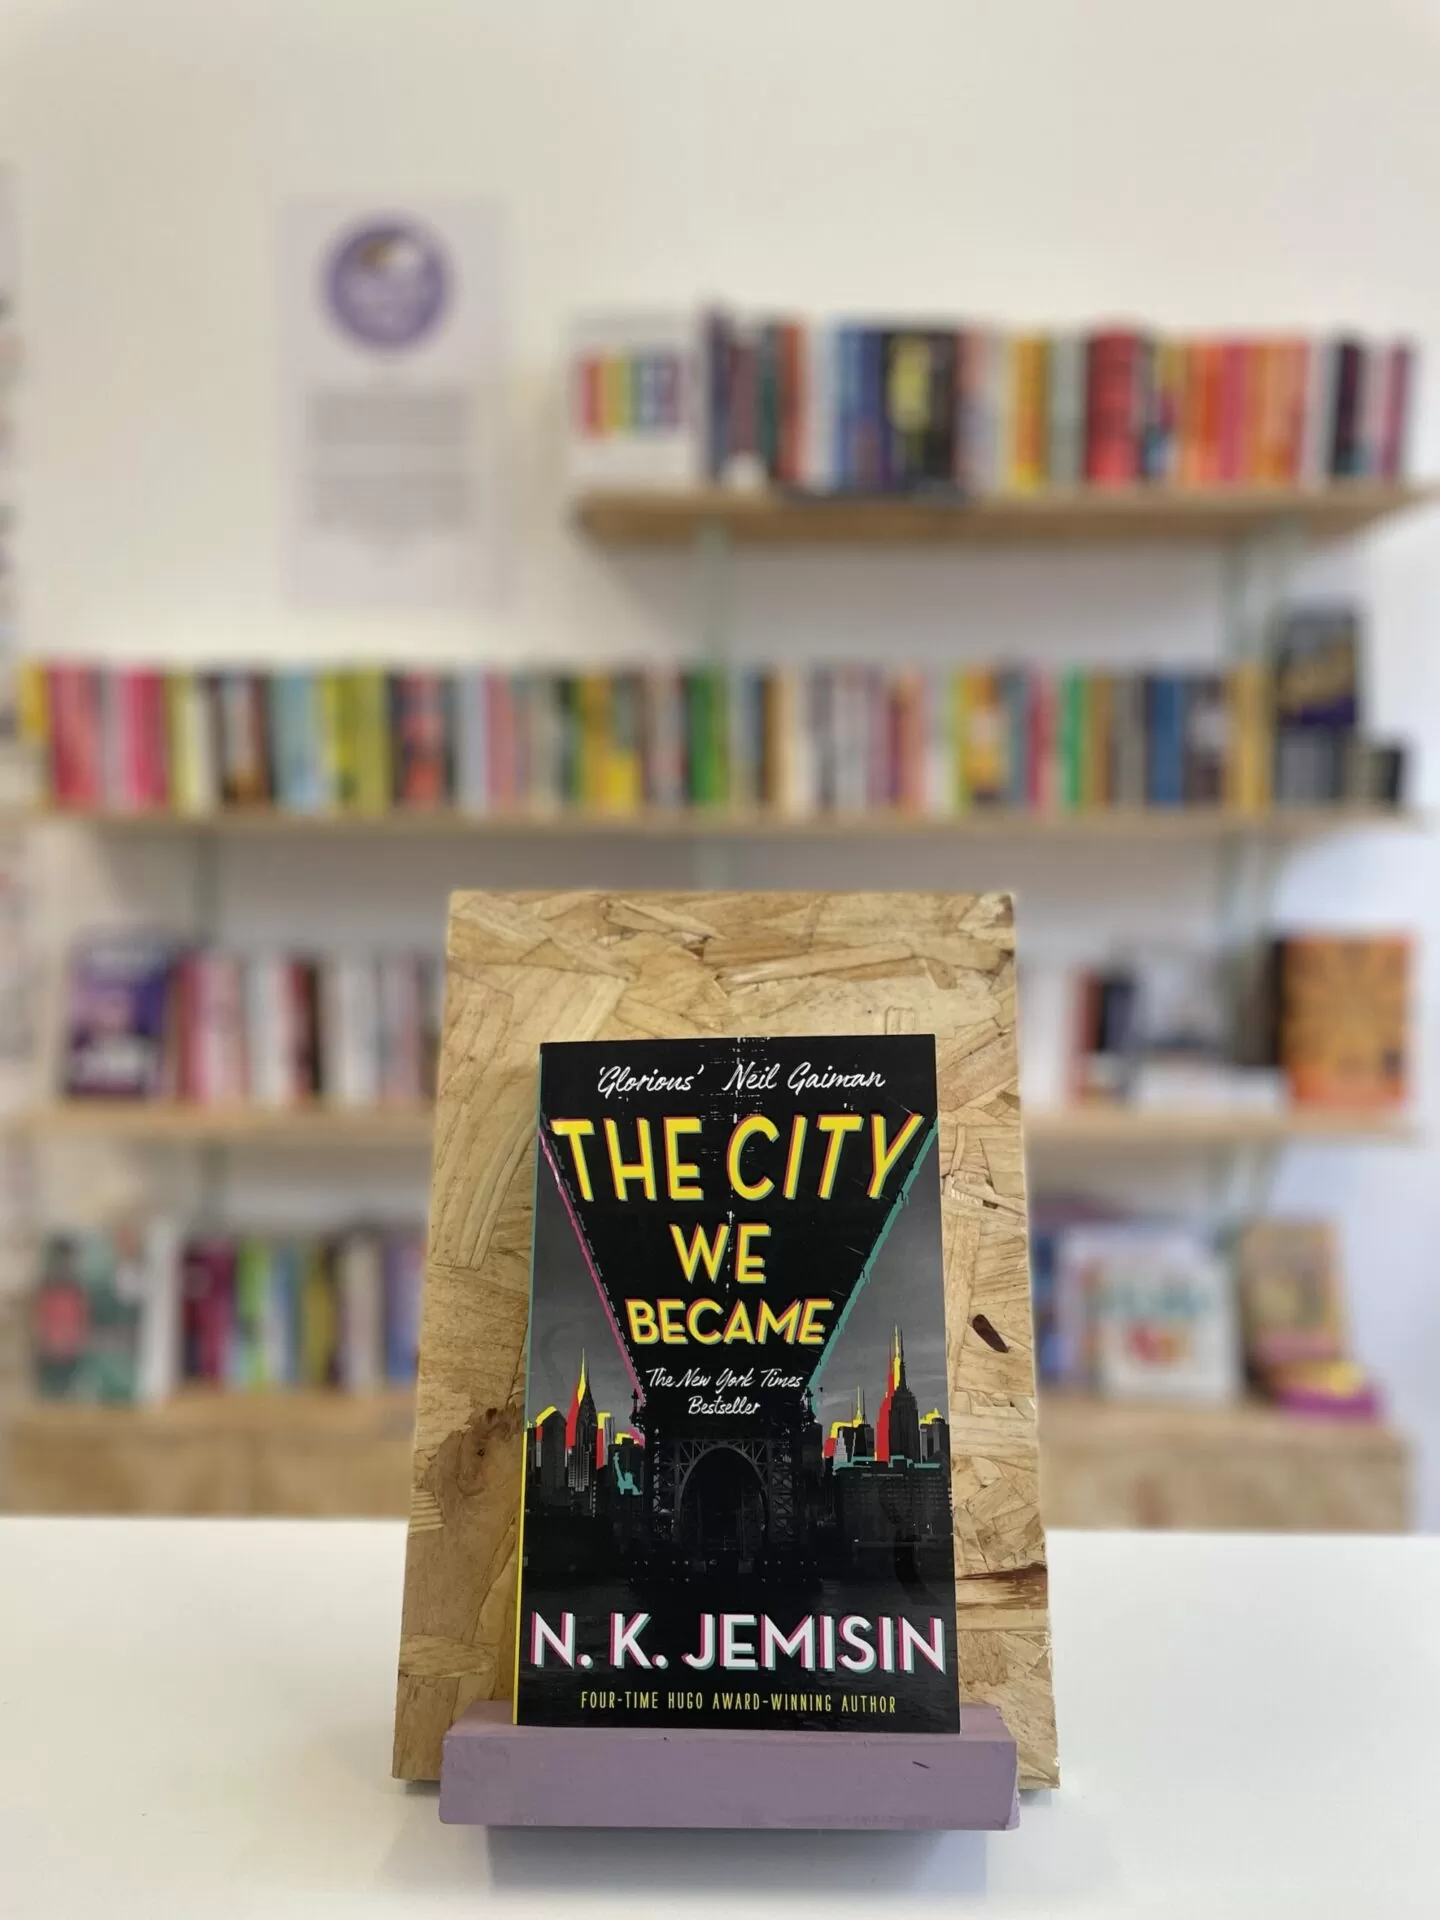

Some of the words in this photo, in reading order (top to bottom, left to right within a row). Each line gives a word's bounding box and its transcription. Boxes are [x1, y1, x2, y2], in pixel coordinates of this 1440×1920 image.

[722, 1062, 777, 1091] Neil
[787, 1062, 886, 1094] Gaiman
[550, 1117, 704, 1202] THE
[726, 1112, 925, 1201] CITY
[669, 1223, 771, 1284] WE
[625, 1298, 833, 1345] BECAME
[645, 1368, 675, 1388] The
[676, 1368, 709, 1388] New
[715, 1367, 753, 1393] York
[759, 1367, 803, 1388] Times
[688, 1397, 760, 1415] Bestseller
[530, 1611, 593, 1669] N.
[609, 1612, 668, 1670] K.
[682, 1613, 946, 1675] JEMISIN
[581, 1691, 659, 1709] FOUR-TIME
[668, 1692, 703, 1710] HUGO
[712, 1692, 832, 1712] AWARD-WINNING
[842, 1694, 896, 1714] AUTHOR
